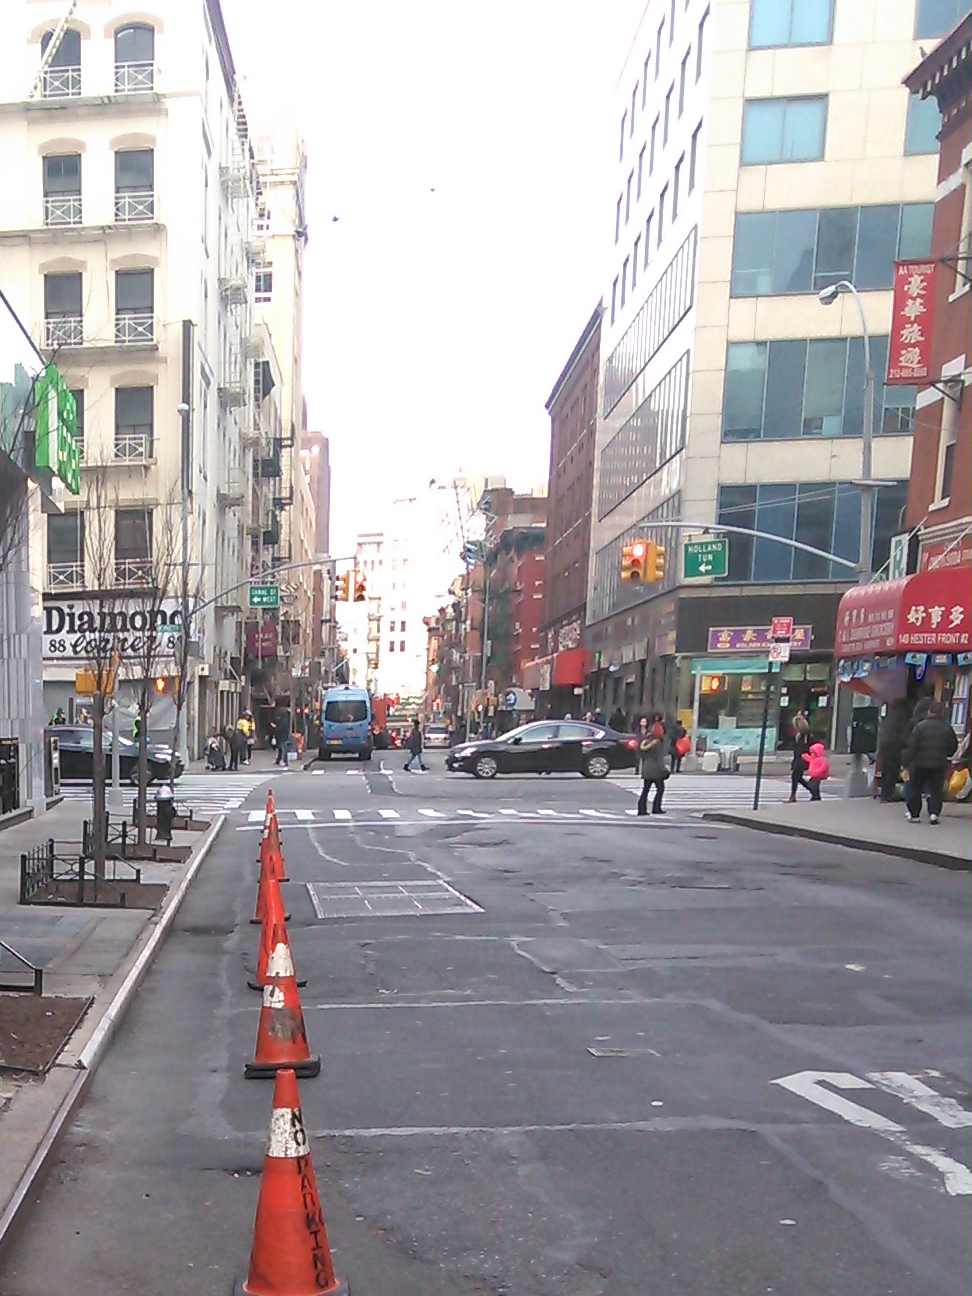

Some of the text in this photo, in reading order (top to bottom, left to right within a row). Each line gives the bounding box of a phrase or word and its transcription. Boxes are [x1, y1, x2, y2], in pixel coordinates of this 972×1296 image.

[688, 543, 723, 553] HOLLAND
[698, 553, 713, 562] TUN
[907, 605, 965, 629] 好事多
[910, 633, 936, 644] HESTER
[937, 633, 960, 644] FRONT
[49, 639, 66, 653] 88
